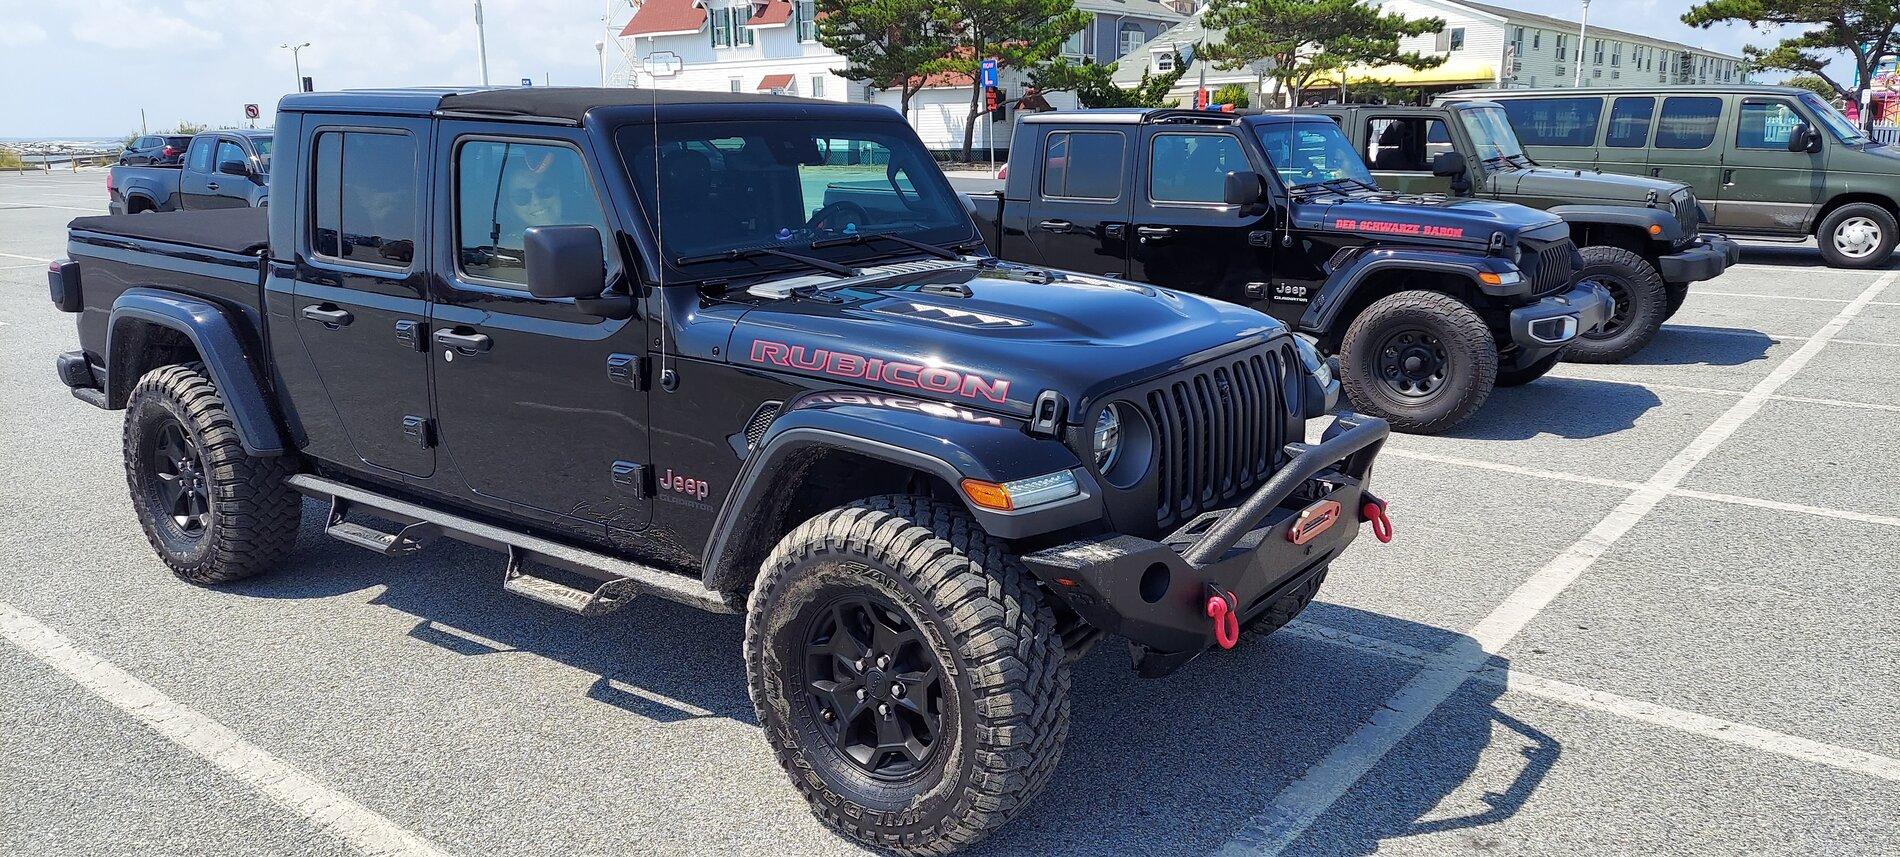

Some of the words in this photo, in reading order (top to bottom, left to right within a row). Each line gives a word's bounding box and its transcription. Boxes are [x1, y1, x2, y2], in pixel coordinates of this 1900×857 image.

[1335, 219, 1357, 230] DER
[1359, 220, 1420, 234] SCHWARZE
[1423, 225, 1463, 237] BARON
[1276, 282, 1307, 297] Jeep
[750, 339, 1011, 403] RUBICON
[659, 469, 709, 501] Jeep
[659, 494, 714, 513] GLADIATOR
